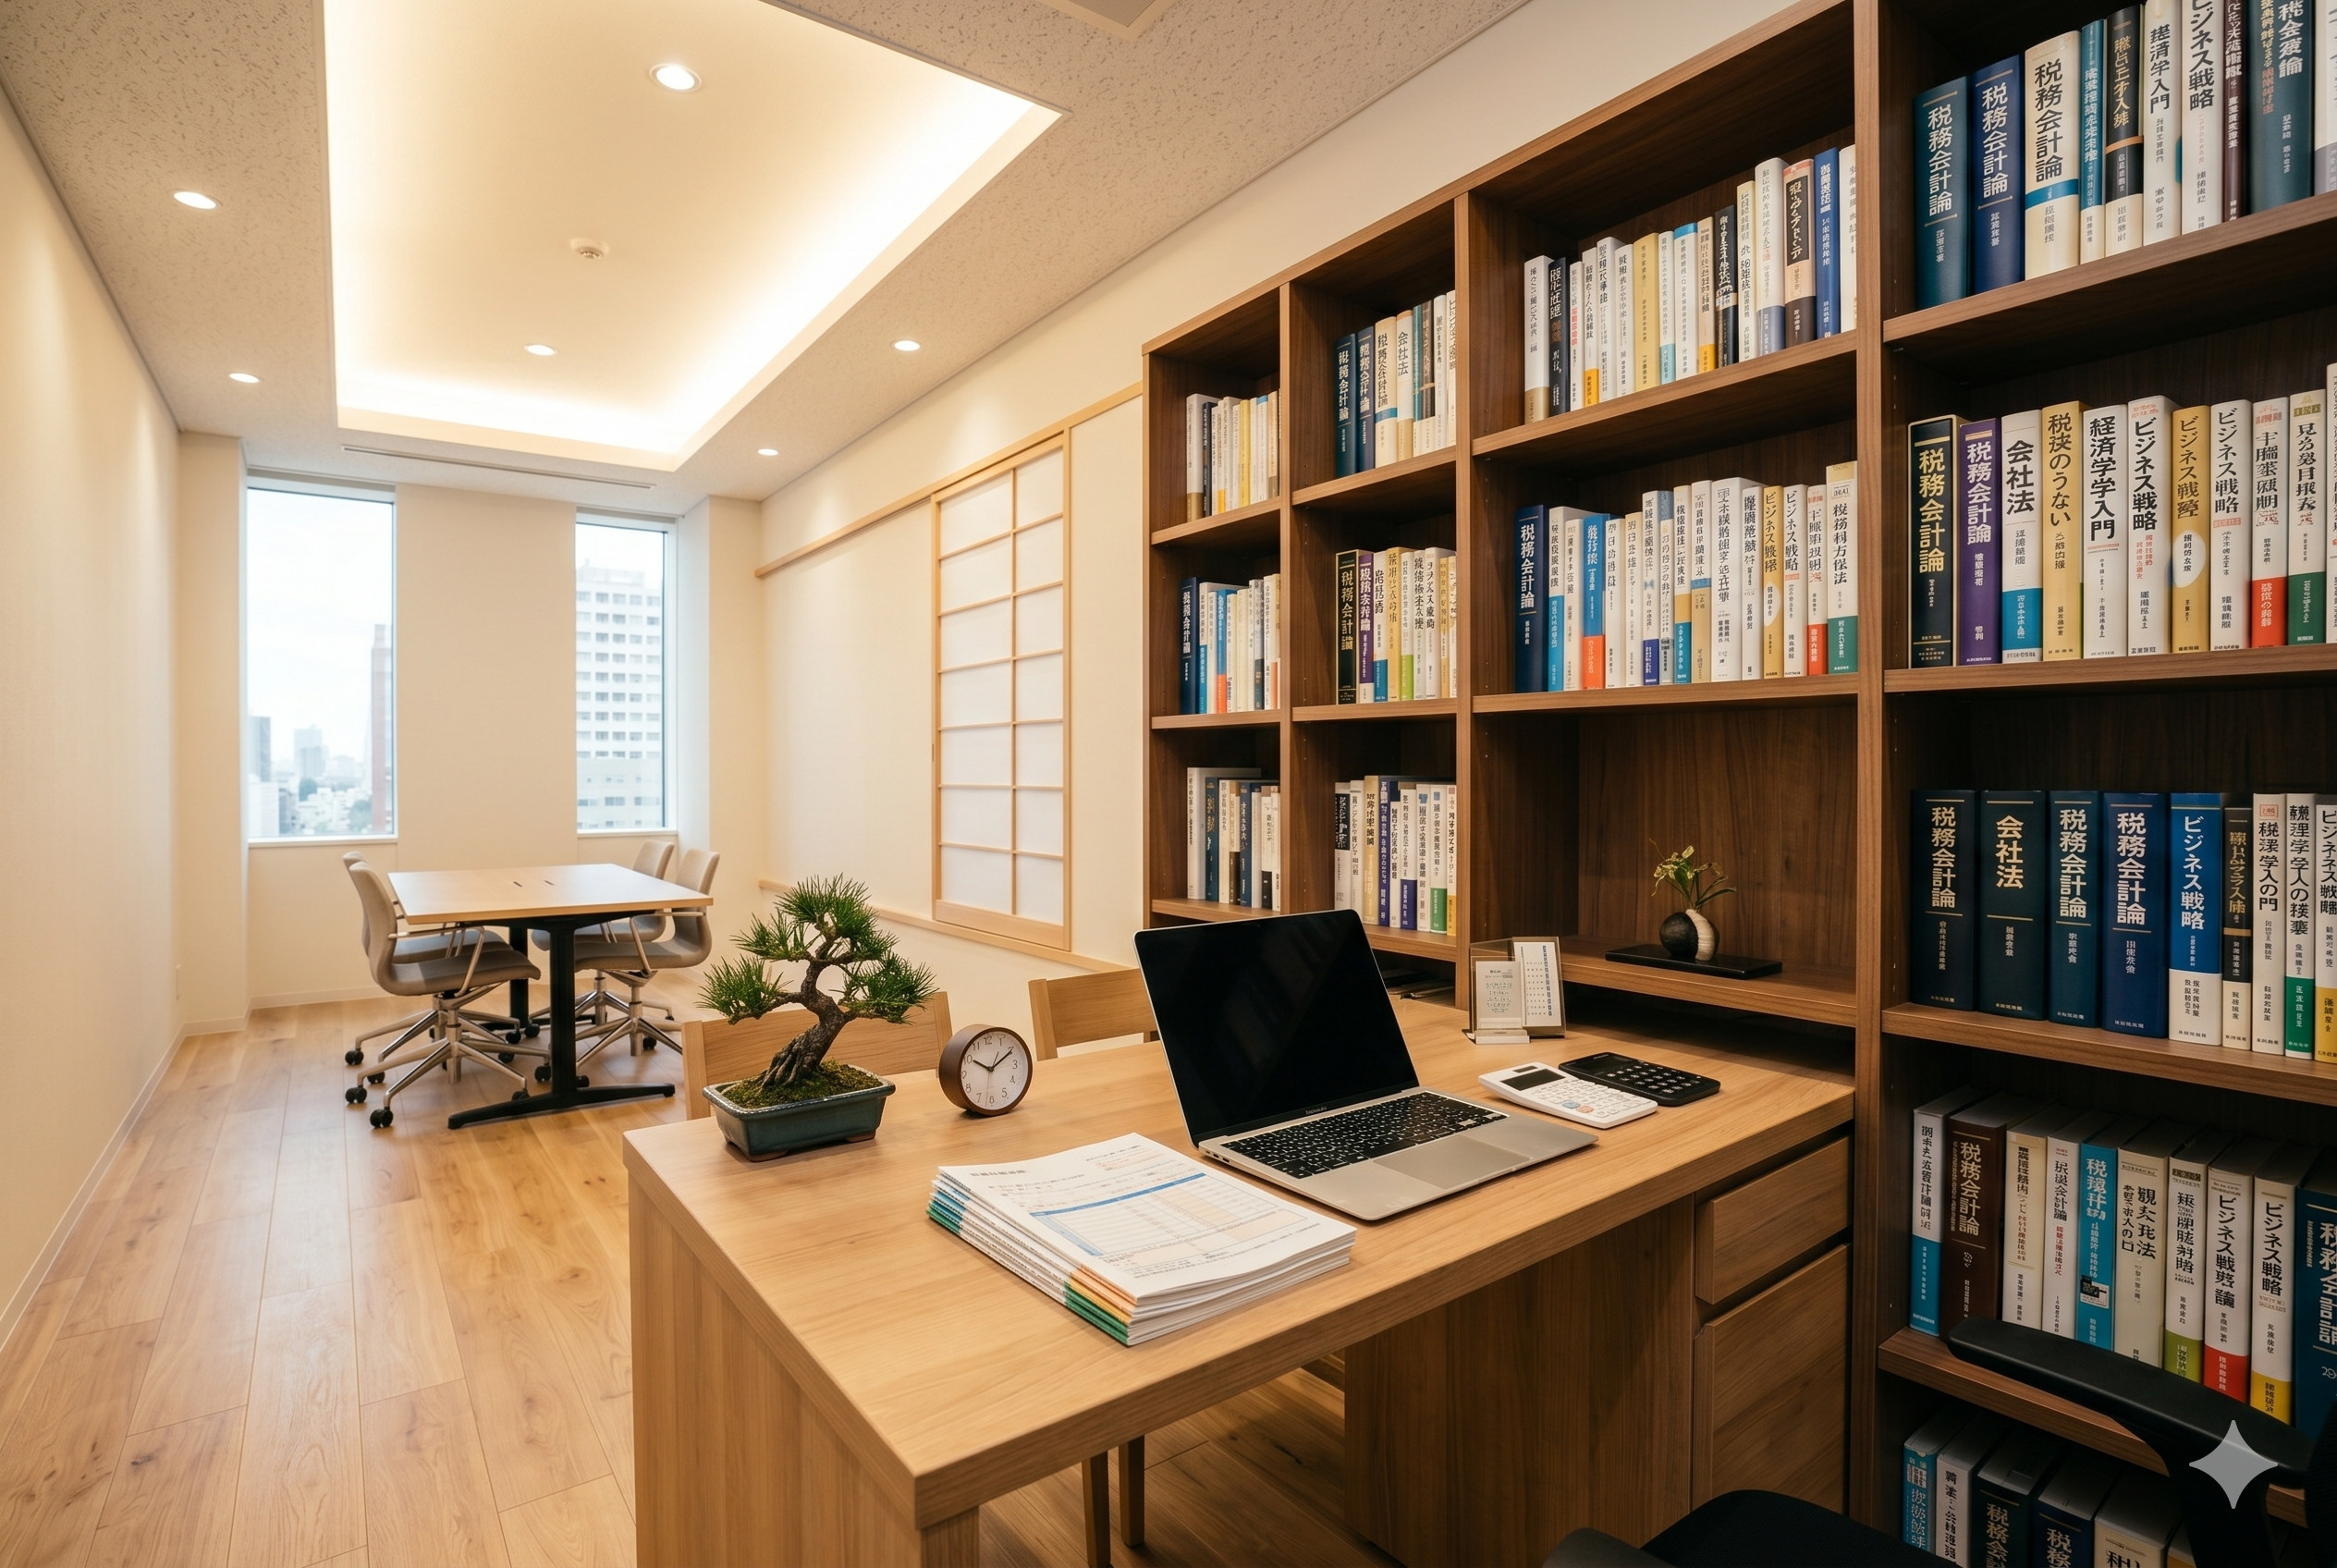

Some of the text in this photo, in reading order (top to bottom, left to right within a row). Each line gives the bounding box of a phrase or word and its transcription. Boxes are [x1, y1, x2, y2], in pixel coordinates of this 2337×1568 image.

[1927, 104, 1952, 216] 税務会計論
[1981, 82, 2008, 199] 税務会計論
[2034, 58, 2063, 182] 税務会計論
[1918, 447, 1945, 573] 税務会計論
[1966, 441, 1992, 545] 税務会計論
[2006, 439, 2036, 516] 会社法
[2089, 415, 2116, 541] 経済学学入門
[2132, 417, 2158, 532] ビジネス戦略
[2214, 408, 2239, 514] ビジネス戦略
[1931, 806, 1956, 908] 税務会計論
[1995, 815, 2024, 889] 会社法
[2060, 808, 2087, 919] 税務会計論
[2116, 812, 2147, 925] 税務会計論
[2180, 815, 2205, 930] ビジネス戦略
[963, 1054, 973, 1065] 10
[965, 1083, 972, 1093] 8
[973, 1042, 980, 1051] 11
[984, 1035, 993, 1046] 12
[1009, 1075, 1016, 1084] 4
[1012, 1060, 1018, 1070] 3
[976, 1092, 982, 1103] 7
[1001, 1087, 1008, 1098] 5
[2261, 1201, 2284, 1296] ビジネス戦略
